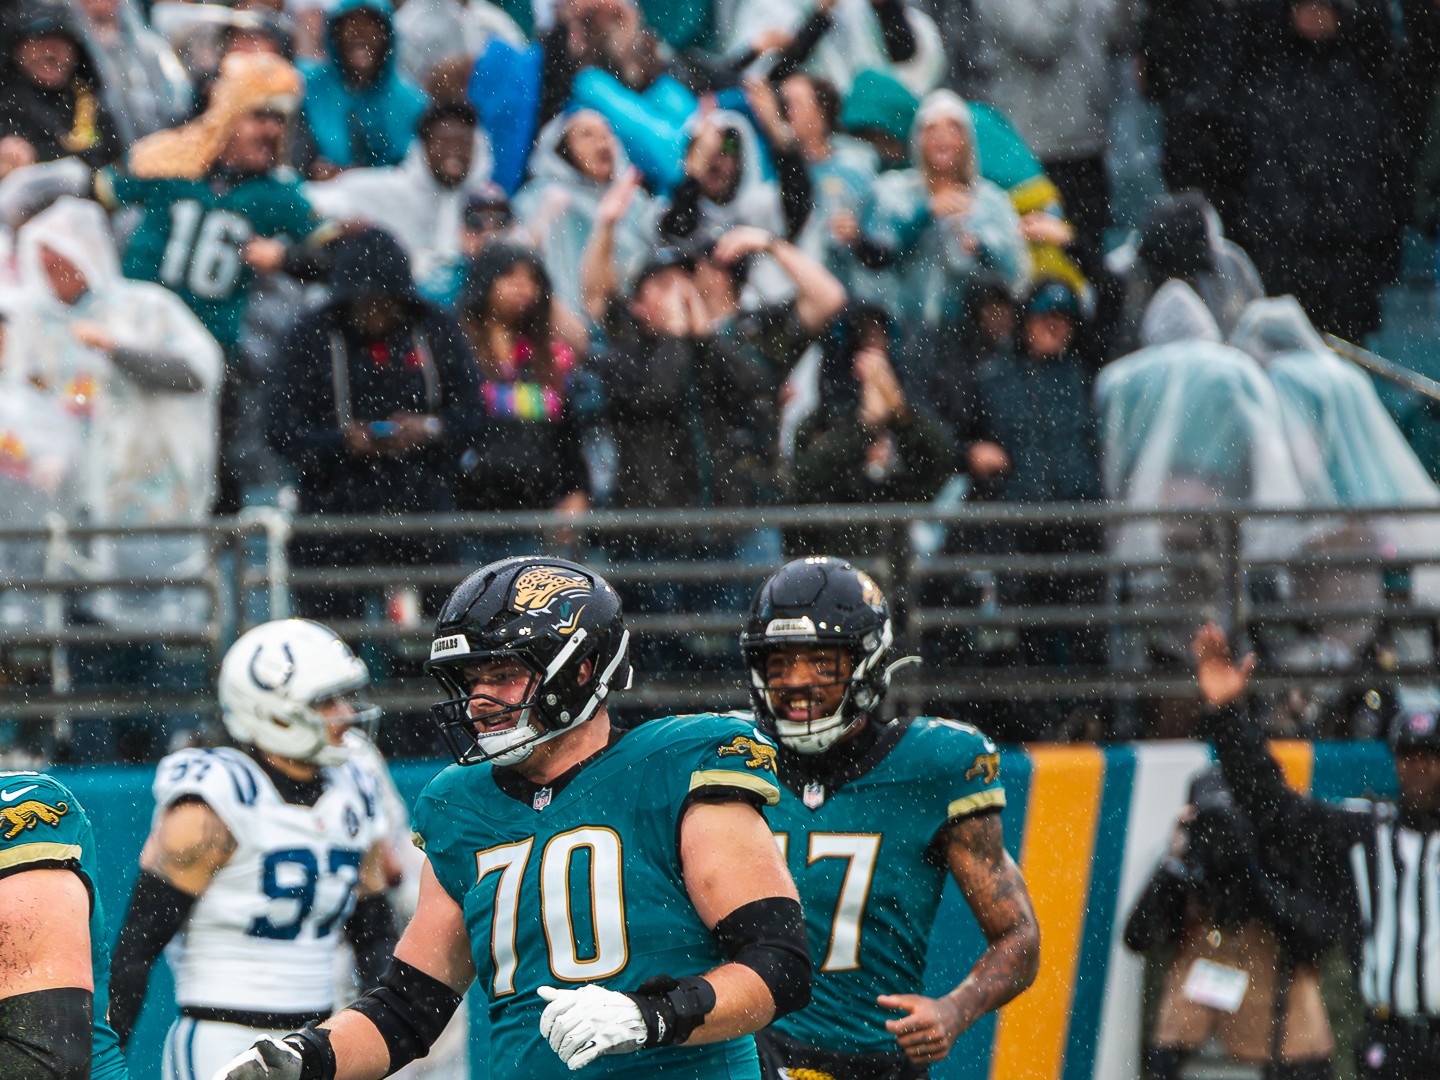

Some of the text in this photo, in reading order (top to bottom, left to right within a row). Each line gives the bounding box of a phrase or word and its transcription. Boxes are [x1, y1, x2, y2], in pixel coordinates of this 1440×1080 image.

[160, 199, 252, 299] 16
[433, 638, 458, 652] JAGUARS
[243, 845, 364, 940] 97
[472, 824, 630, 998] 70
